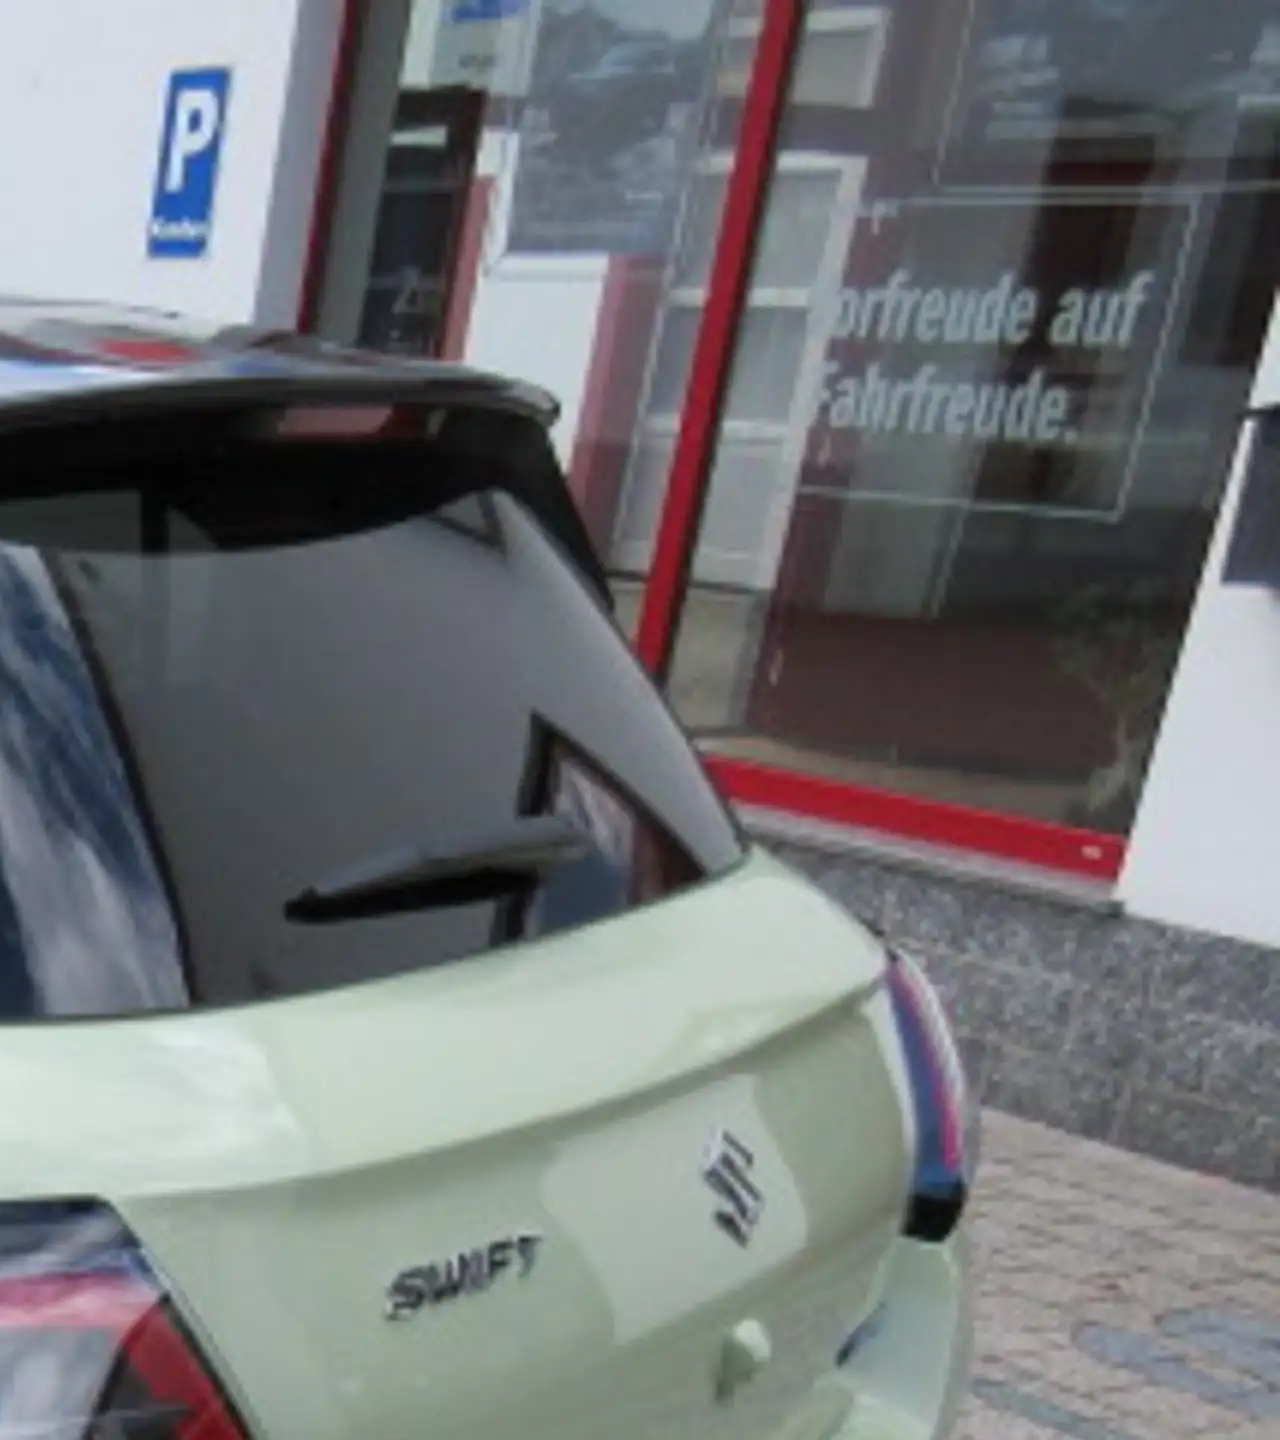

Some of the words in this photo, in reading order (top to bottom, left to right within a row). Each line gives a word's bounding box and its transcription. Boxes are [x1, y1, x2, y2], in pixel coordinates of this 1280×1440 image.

[164, 88, 218, 194] P
[828, 269, 1037, 345] orfreude
[1048, 269, 1155, 348] auf
[384, 1234, 542, 1322] SWIFT
